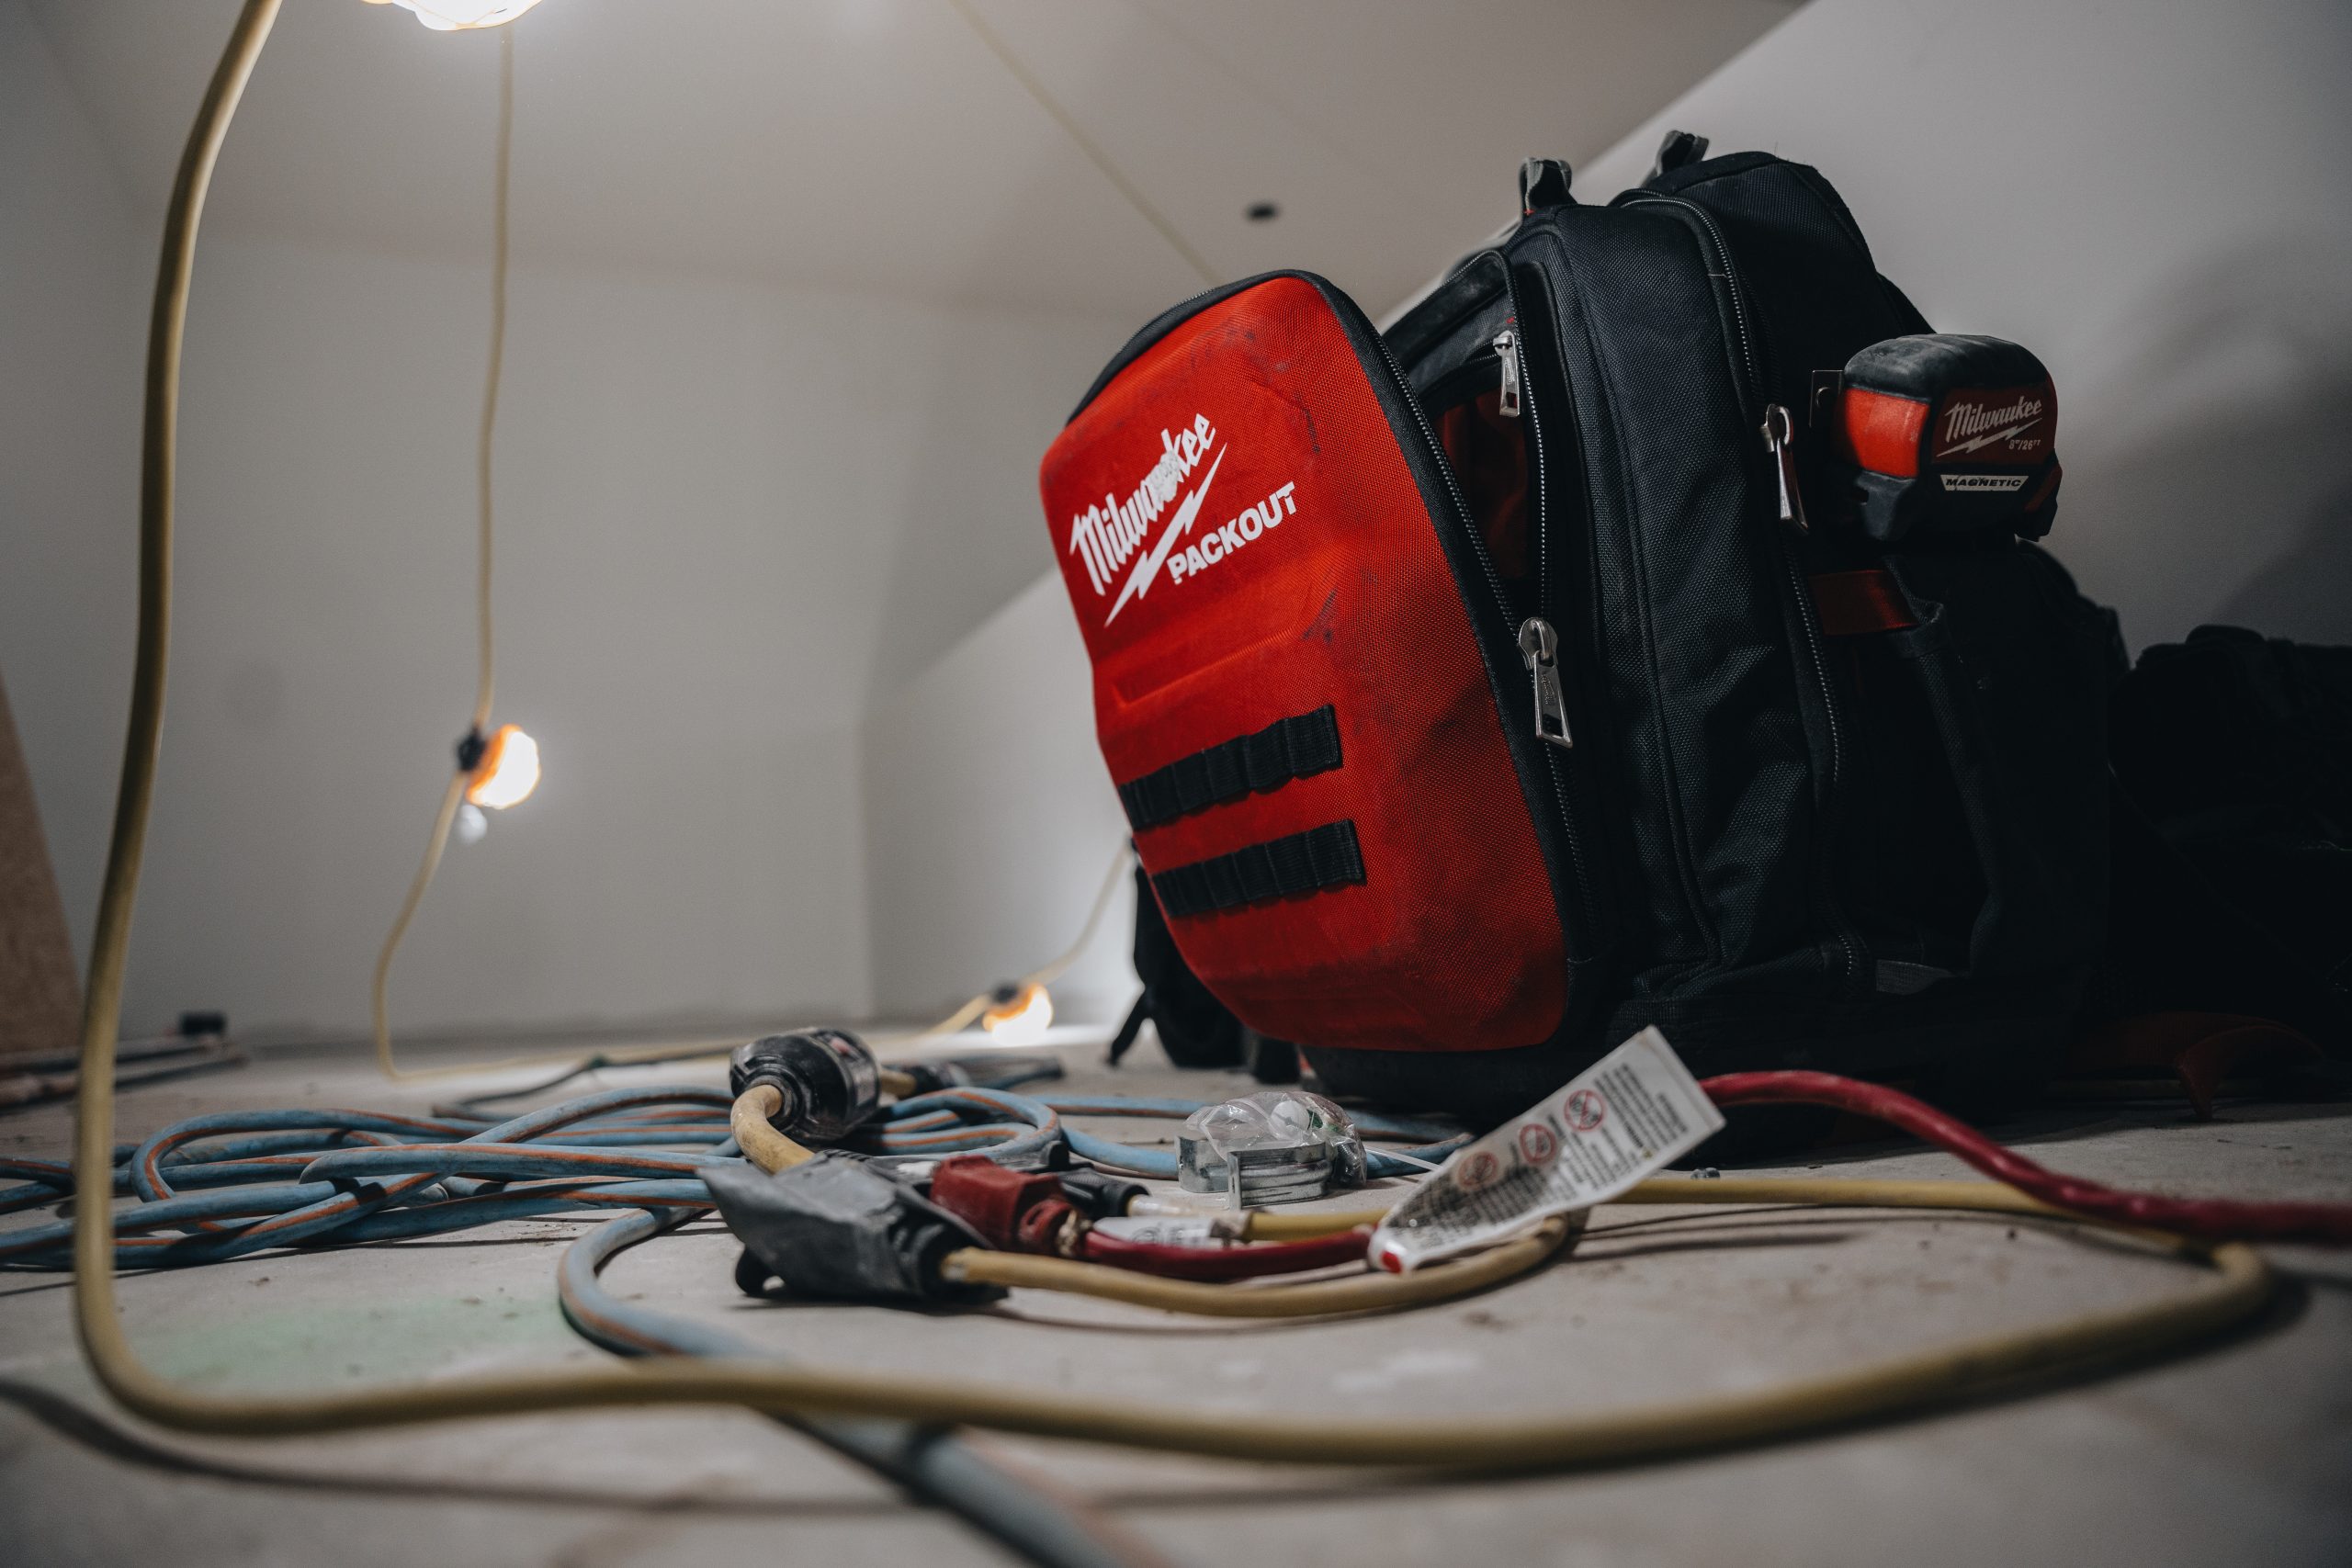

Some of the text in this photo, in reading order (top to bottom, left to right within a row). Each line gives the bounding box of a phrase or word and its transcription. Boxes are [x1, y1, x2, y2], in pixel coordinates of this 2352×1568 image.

[1945, 396, 2041, 443] Milwaukee
[1070, 413, 1216, 596] Milwakee
[1945, 479, 2022, 488] MAGNETIC
[1167, 481, 1296, 585] PACKOUT
